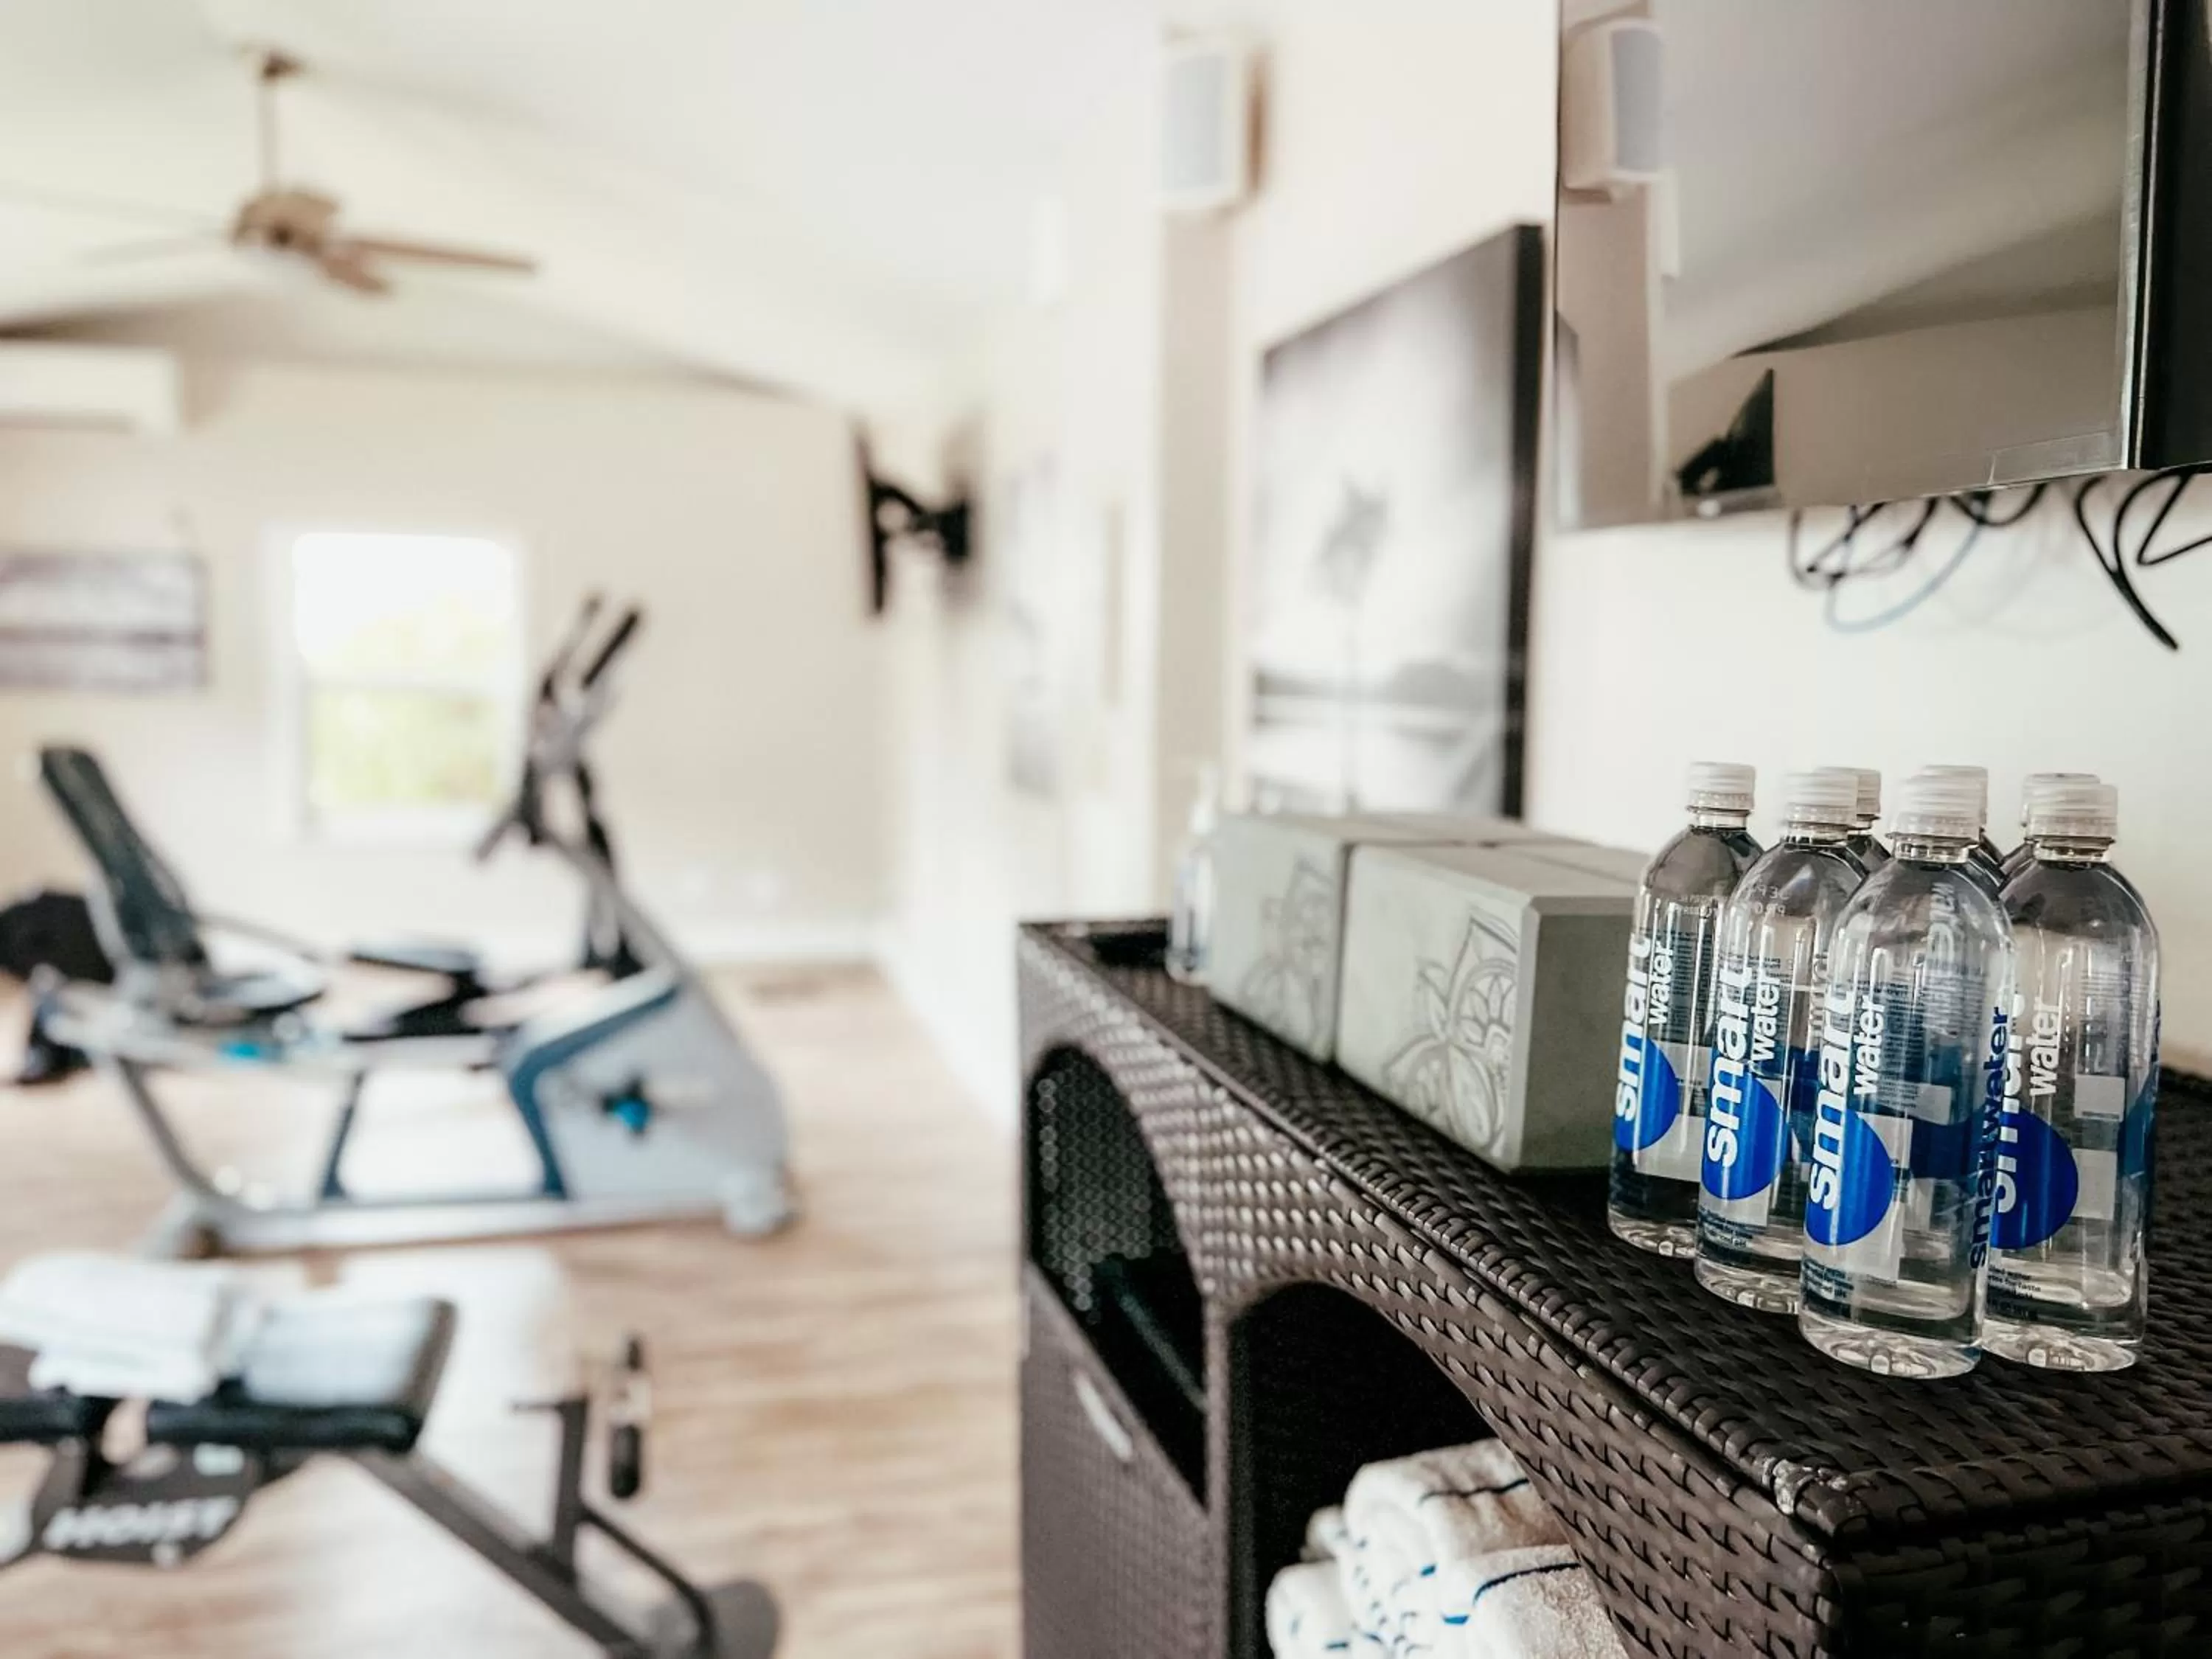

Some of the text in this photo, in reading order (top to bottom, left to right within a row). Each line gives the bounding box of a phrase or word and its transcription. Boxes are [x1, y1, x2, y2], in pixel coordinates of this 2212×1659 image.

[1615, 933, 1651, 1121] smart
[1649, 941, 1673, 1025] water
[1750, 971, 1781, 1061] water
[1707, 964, 1752, 1168] smart
[1853, 995, 1885, 1095] water
[2026, 1000, 2060, 1096] water
[1810, 988, 1856, 1210] smart
